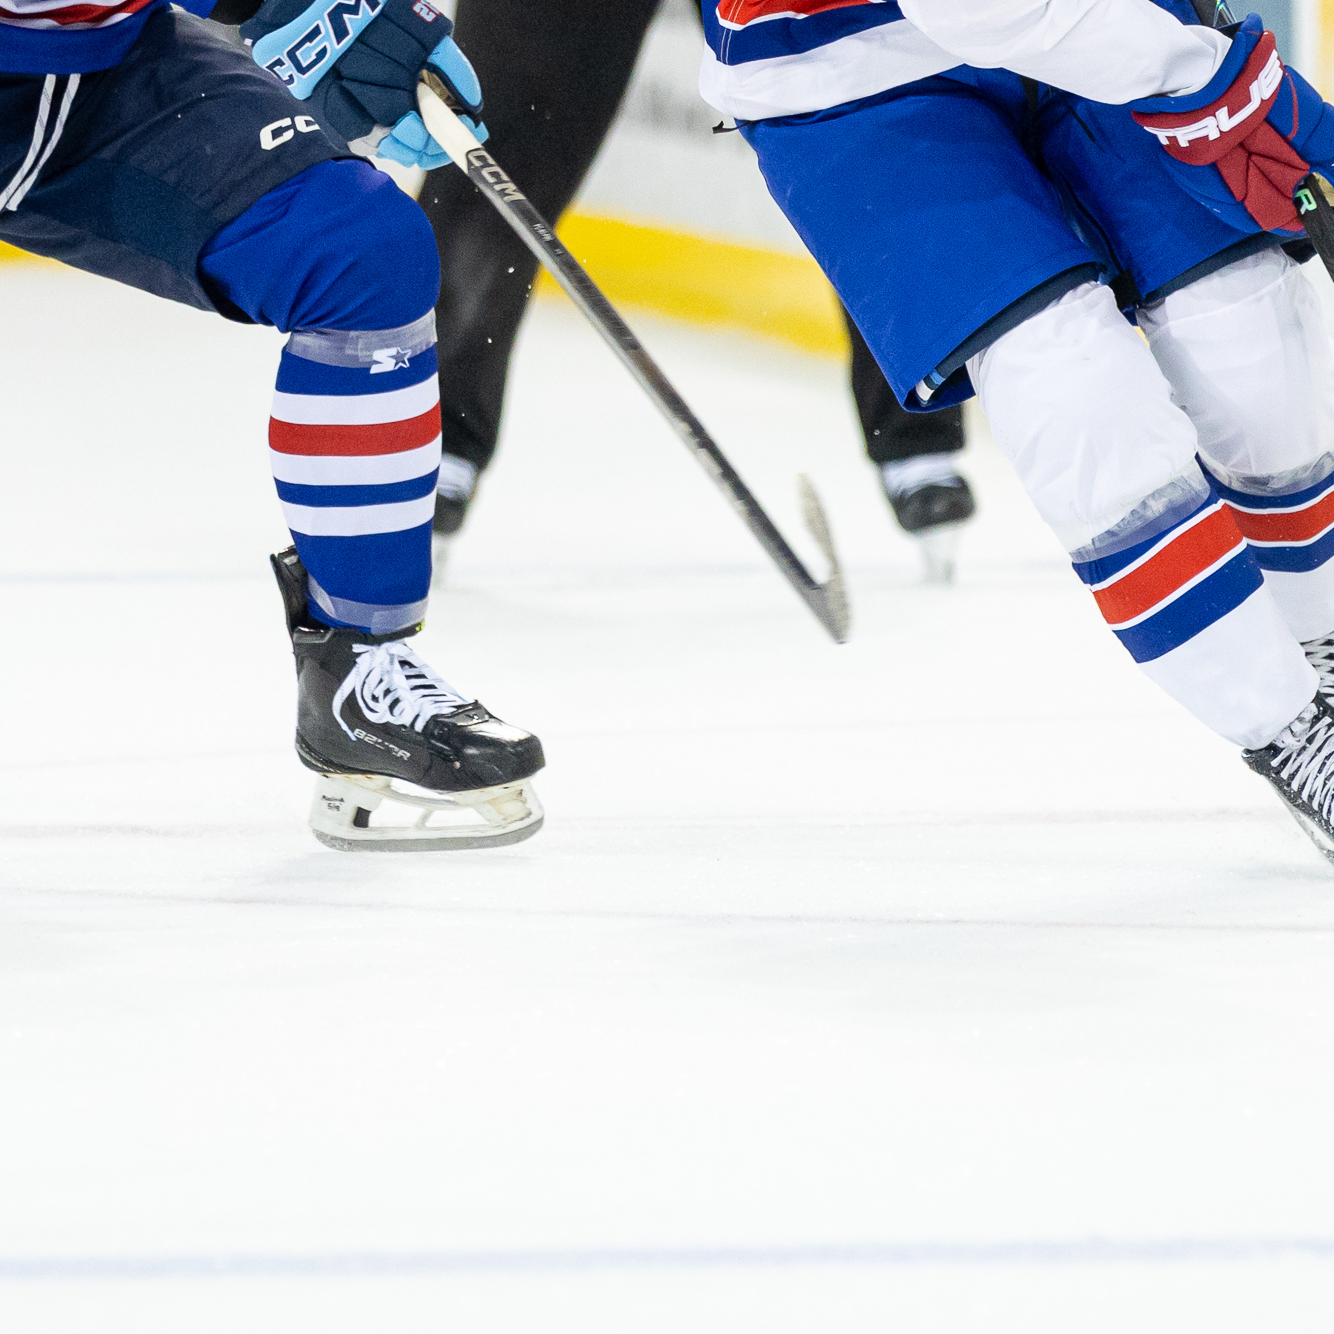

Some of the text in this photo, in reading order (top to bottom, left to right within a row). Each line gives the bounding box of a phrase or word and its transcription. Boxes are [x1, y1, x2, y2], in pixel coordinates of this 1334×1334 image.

[1144, 48, 1284, 148] TRUE
[259, 115, 321, 151] CC
[467, 148, 526, 204] CCM
